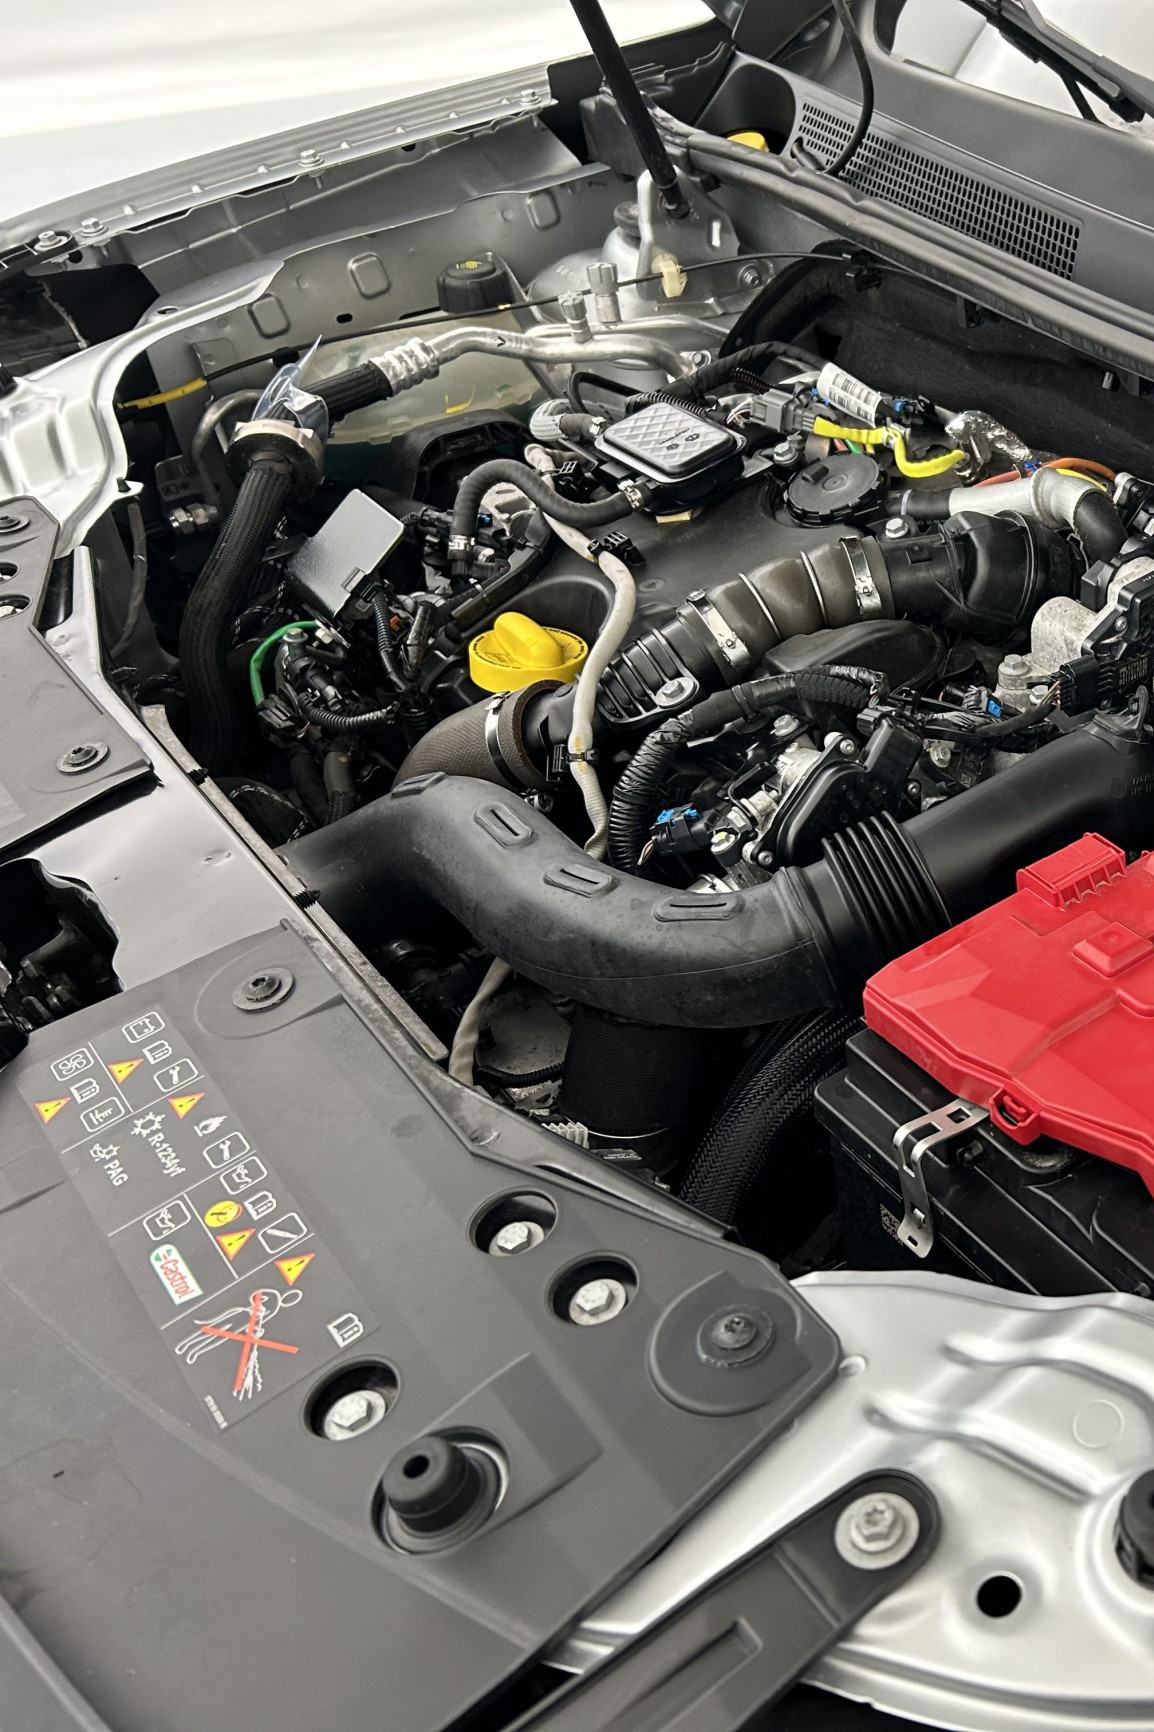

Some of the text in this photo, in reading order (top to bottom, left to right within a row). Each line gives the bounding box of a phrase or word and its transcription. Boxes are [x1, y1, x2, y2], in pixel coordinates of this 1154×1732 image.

[104, 1159, 129, 1187] PAG
[149, 1132, 187, 1178] R-1234yf
[160, 1257, 196, 1299] Castrol
